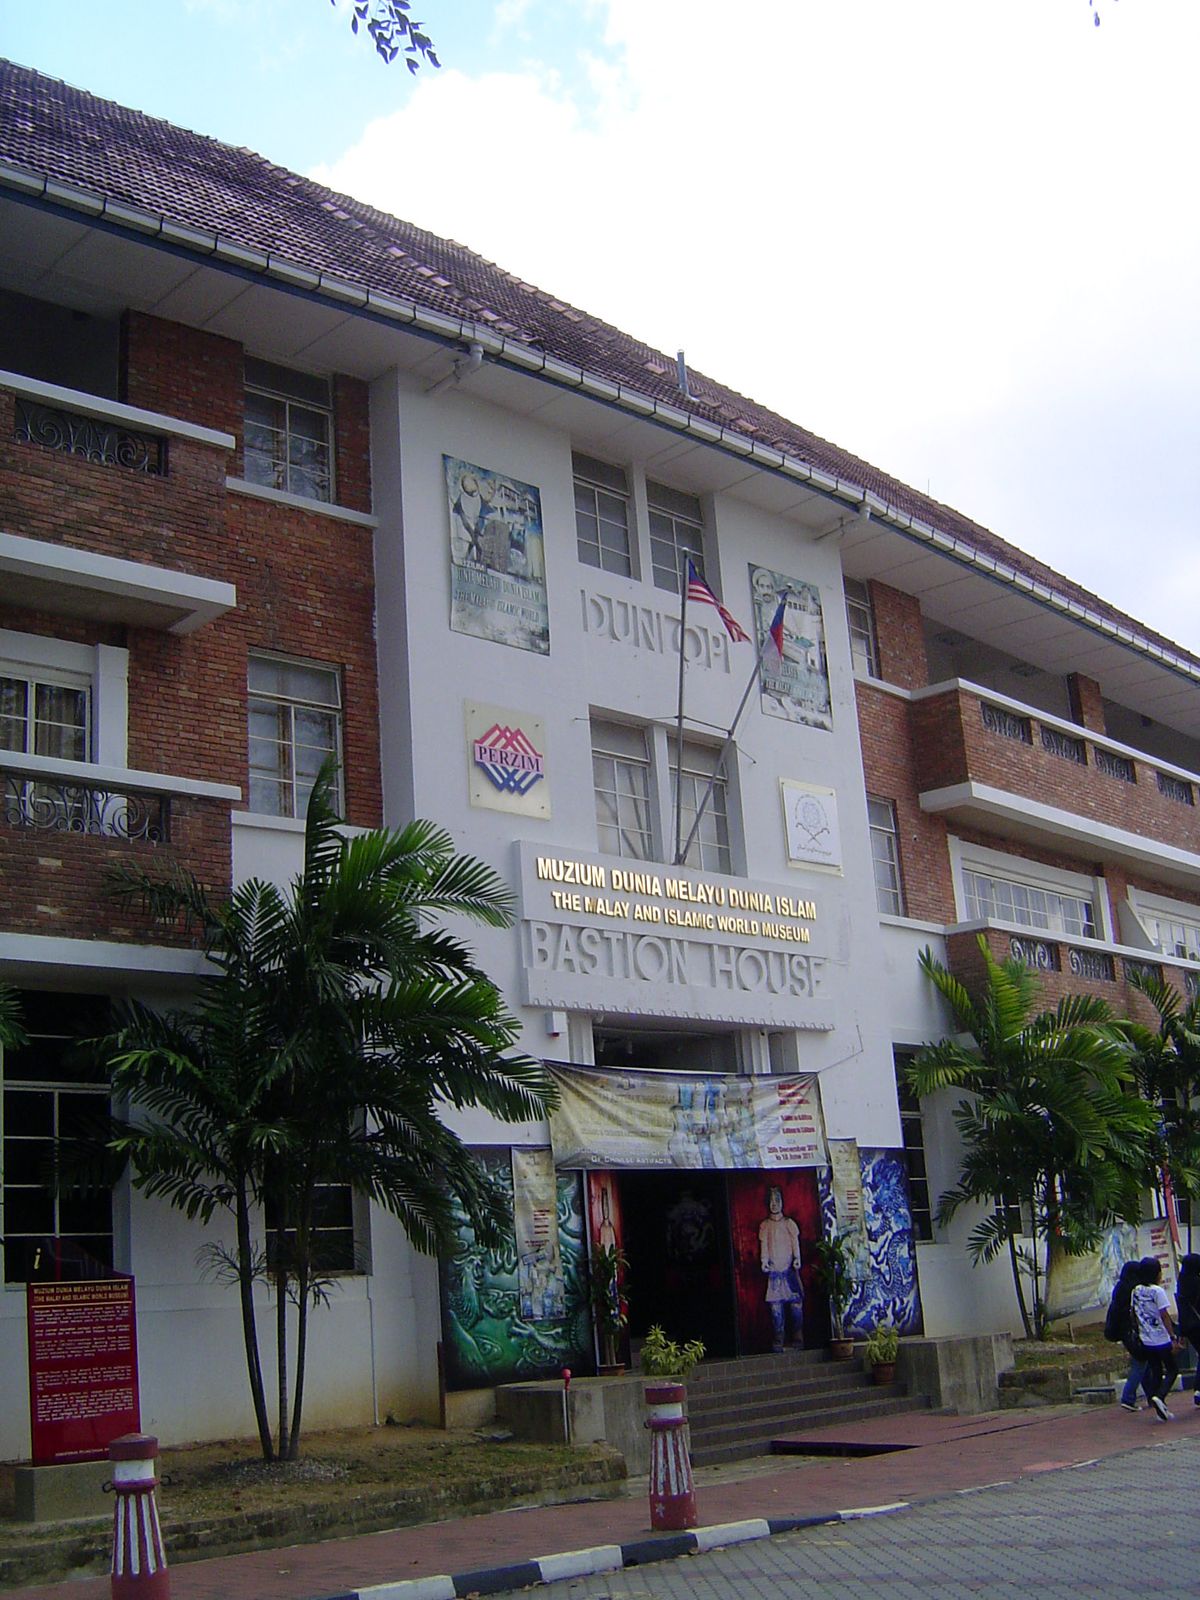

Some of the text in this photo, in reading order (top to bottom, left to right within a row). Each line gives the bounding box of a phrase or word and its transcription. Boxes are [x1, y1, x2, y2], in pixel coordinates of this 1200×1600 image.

[478, 746, 540, 772] PERZIM
[537, 857, 817, 921] MUZIUM DUNIA MELAYU DUNIA ISLAM
[551, 891, 810, 944] THE MALAY AND ISLAMIC WORLD MUSEUM
[530, 921, 827, 999] BASTION HOUSE
